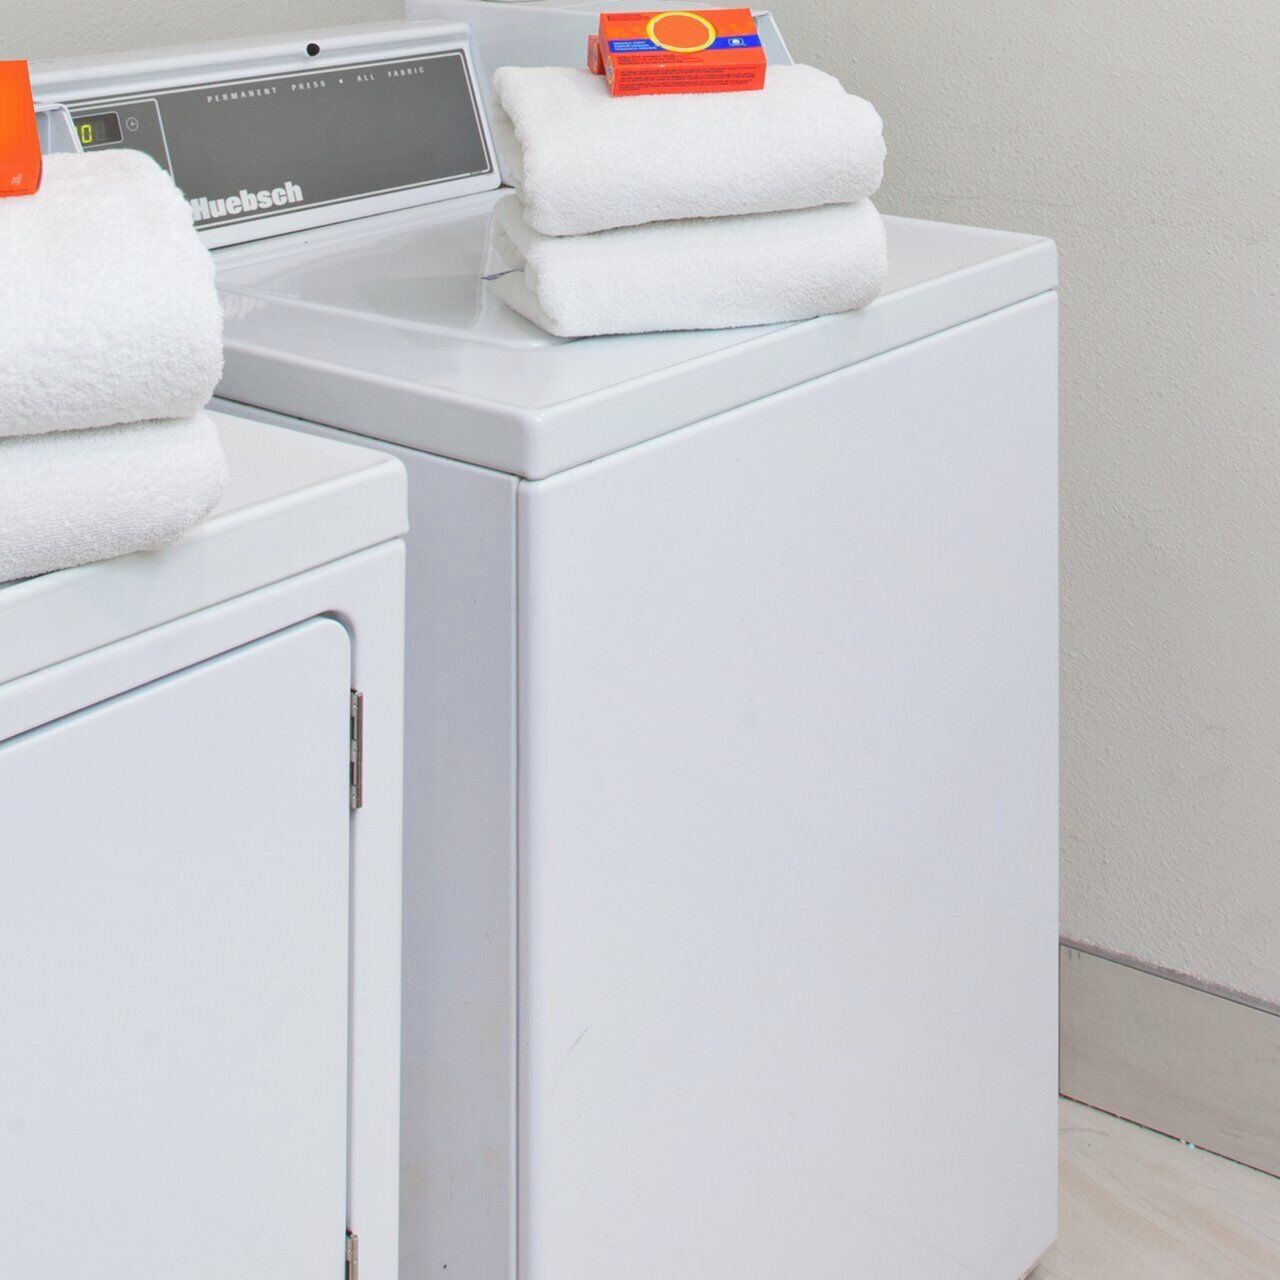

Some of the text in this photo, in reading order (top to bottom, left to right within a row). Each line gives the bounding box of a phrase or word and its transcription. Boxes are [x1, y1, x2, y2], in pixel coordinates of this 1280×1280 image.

[207, 66, 425, 104] PERMANENT PRESS ALL FABRIC
[189, 181, 304, 221] Huebsch
